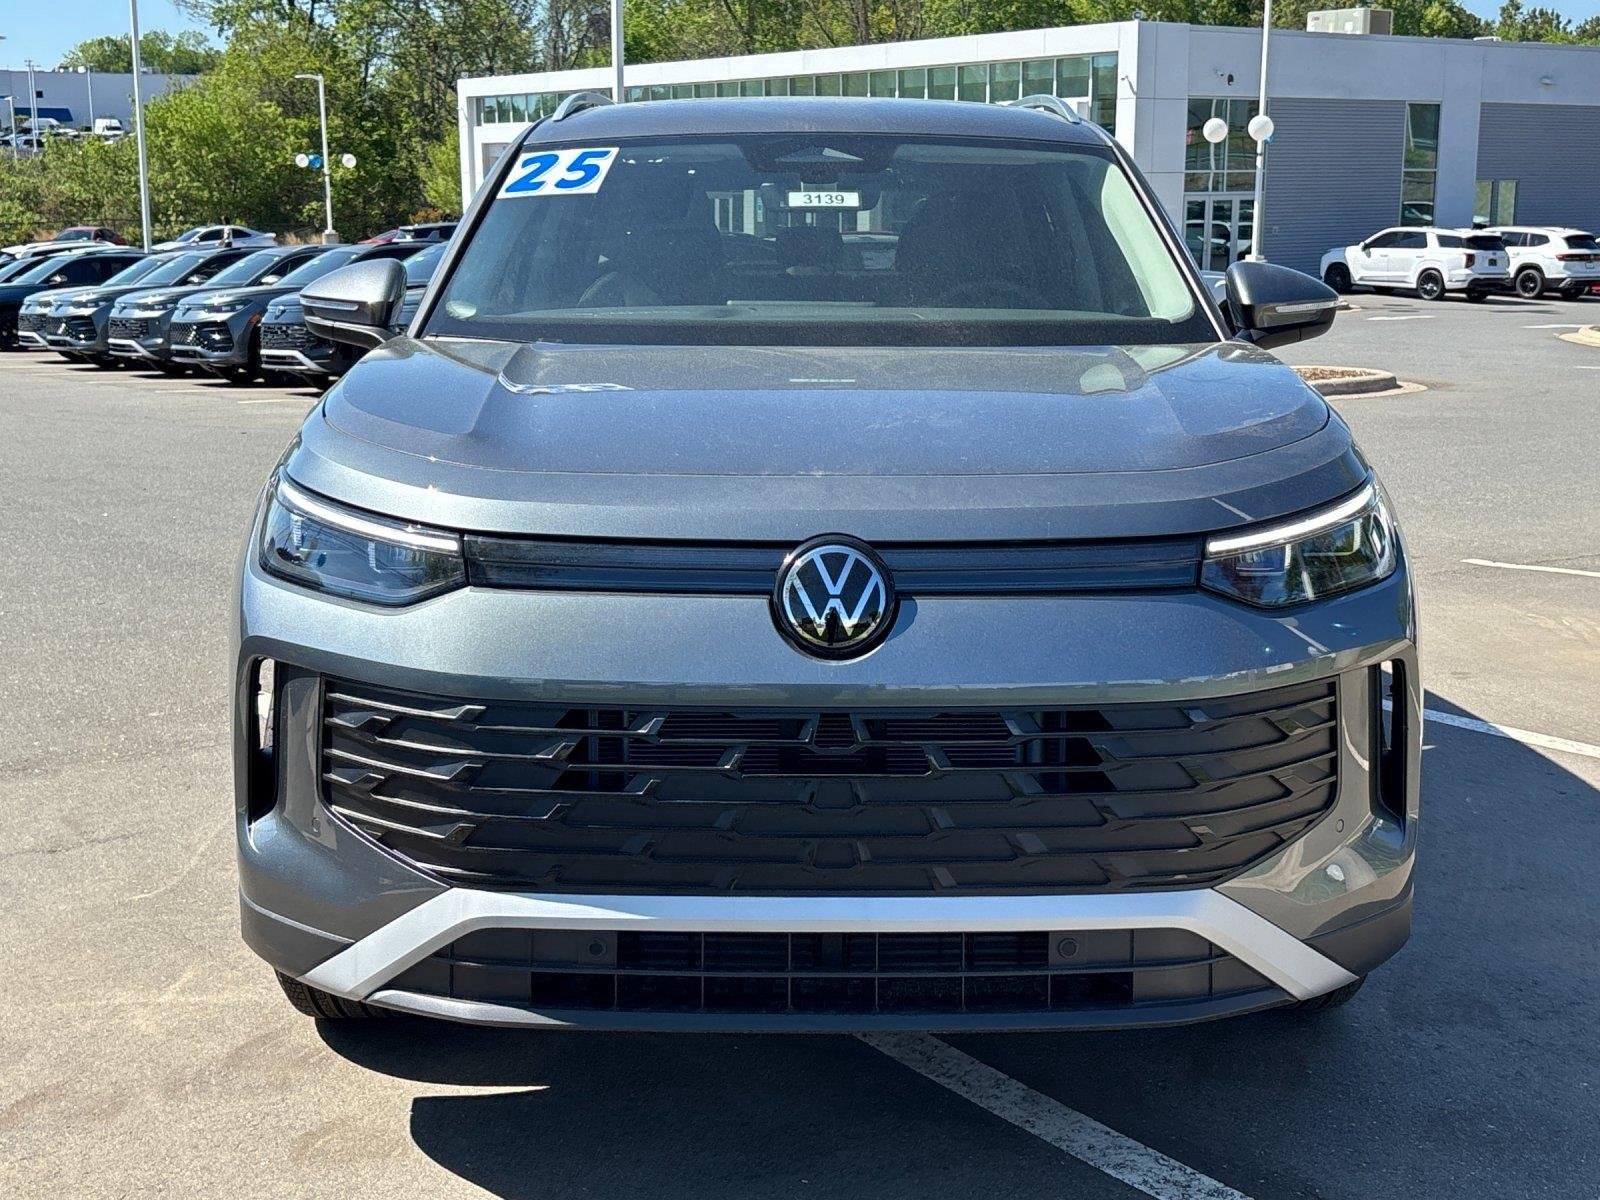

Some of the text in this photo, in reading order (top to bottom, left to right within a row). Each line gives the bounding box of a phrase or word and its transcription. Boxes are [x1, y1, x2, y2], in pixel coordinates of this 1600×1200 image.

[505, 150, 612, 192] 25
[803, 193, 845, 205] 3139
[785, 547, 884, 643] VW
